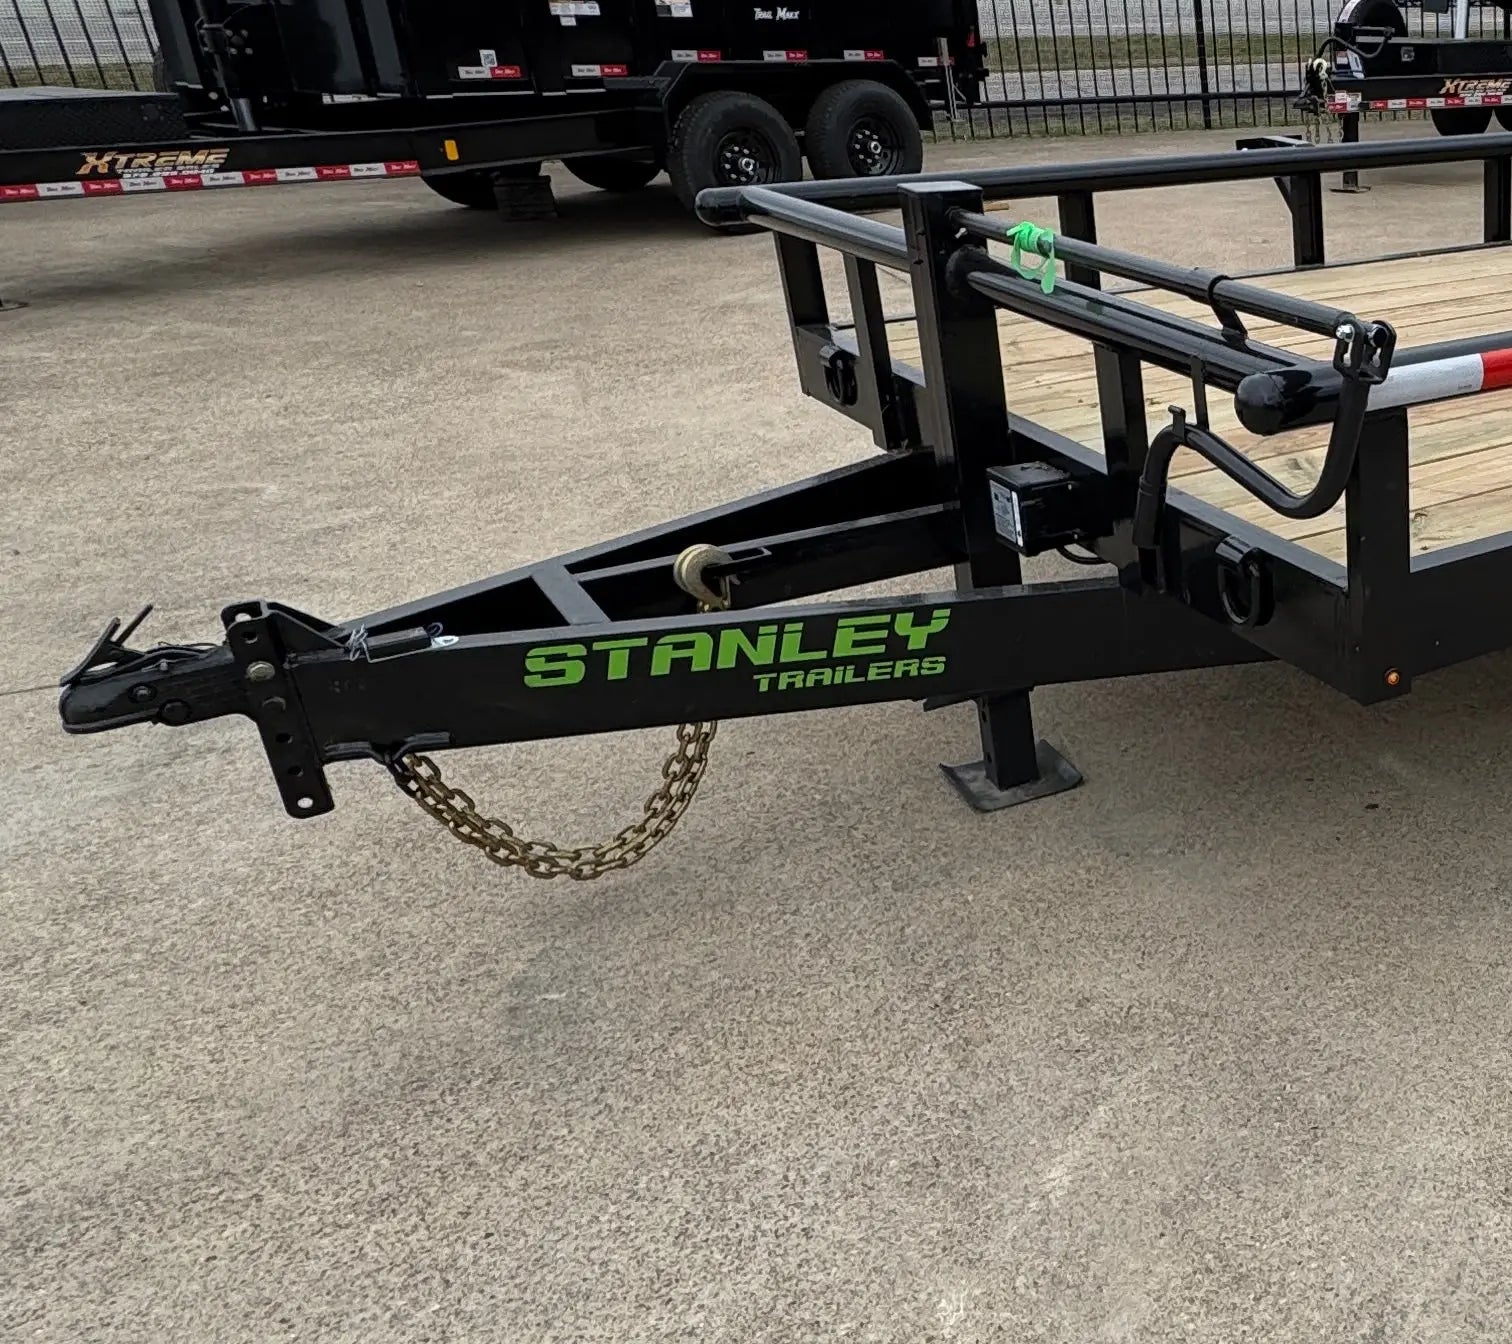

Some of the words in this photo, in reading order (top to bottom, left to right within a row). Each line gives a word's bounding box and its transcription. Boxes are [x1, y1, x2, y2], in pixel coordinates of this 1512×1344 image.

[75, 148, 230, 175] XTREME
[523, 608, 951, 688] STANLEY
[753, 656, 947, 692] TRAILERS
